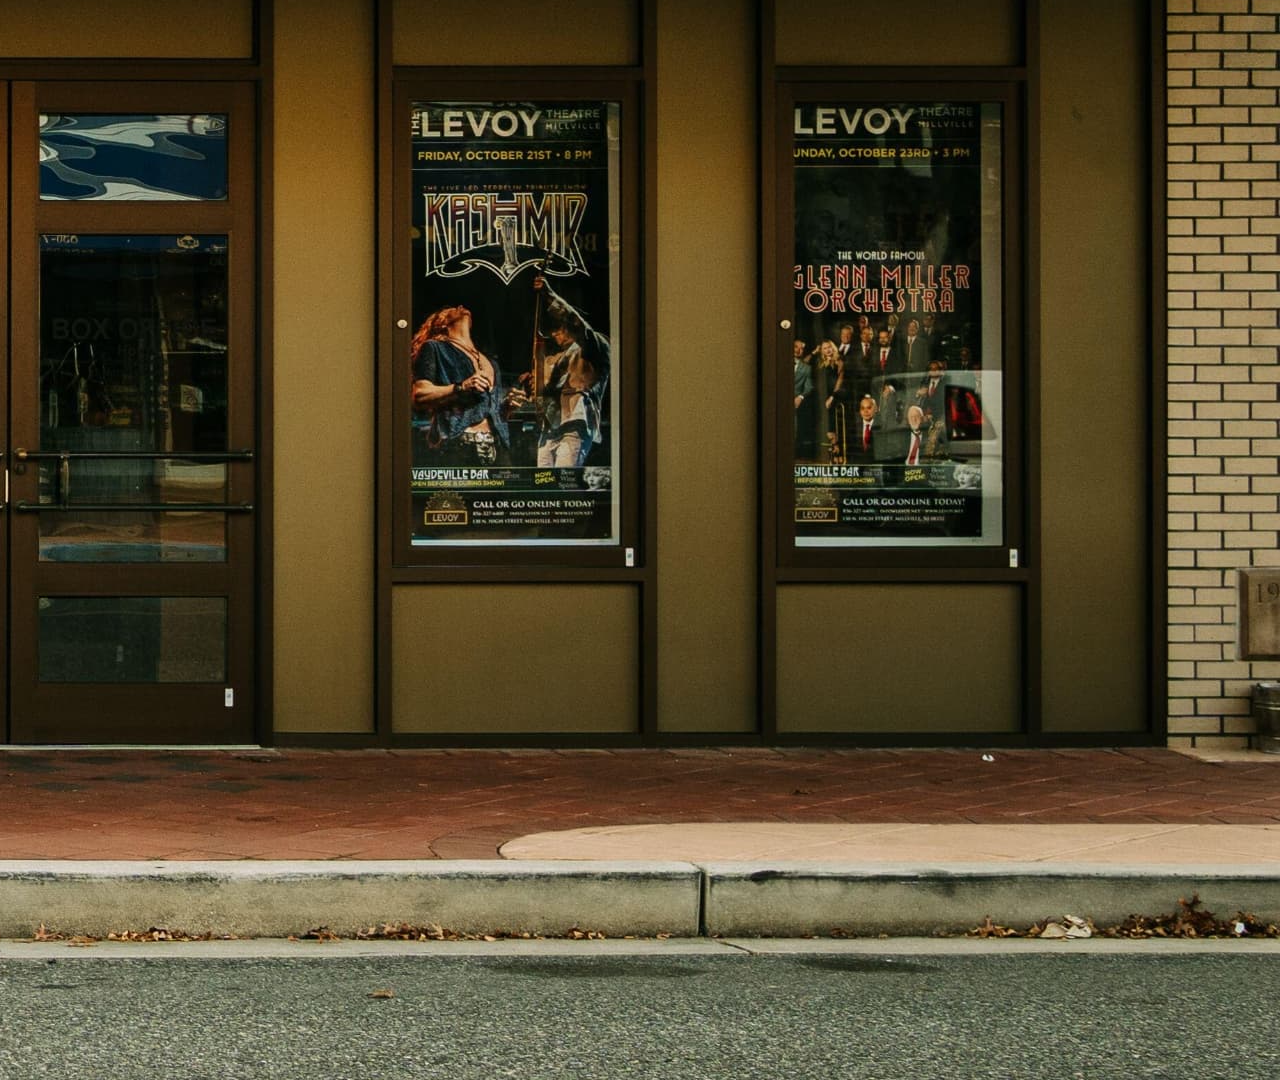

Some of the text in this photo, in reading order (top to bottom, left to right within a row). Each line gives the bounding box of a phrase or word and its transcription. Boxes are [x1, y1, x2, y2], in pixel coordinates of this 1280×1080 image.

[547, 109, 600, 119] THEATRE
[919, 107, 973, 117] THEATRE
[422, 110, 542, 138] LEVOY
[794, 108, 915, 135] LEVOY
[418, 150, 592, 161] FRIDAY, OCTOBER 21ST 8 PM
[793, 148, 970, 159] UNDAY, OCTOBER 23RD 3 PM
[423, 192, 590, 277] KASHMIR
[837, 251, 925, 261] THE WORLD FAMOUS
[793, 264, 971, 289] GLENN MILLER
[803, 288, 955, 312] ORCHESTRA
[470, 469, 489, 480] BAR
[473, 500, 595, 509] CALL OR GO ONLINE TODAY!
[843, 497, 966, 506] CALL OR GO ONLINE TODAY!
[432, 514, 460, 522] LEVOY
[802, 511, 829, 520] LEVOY
